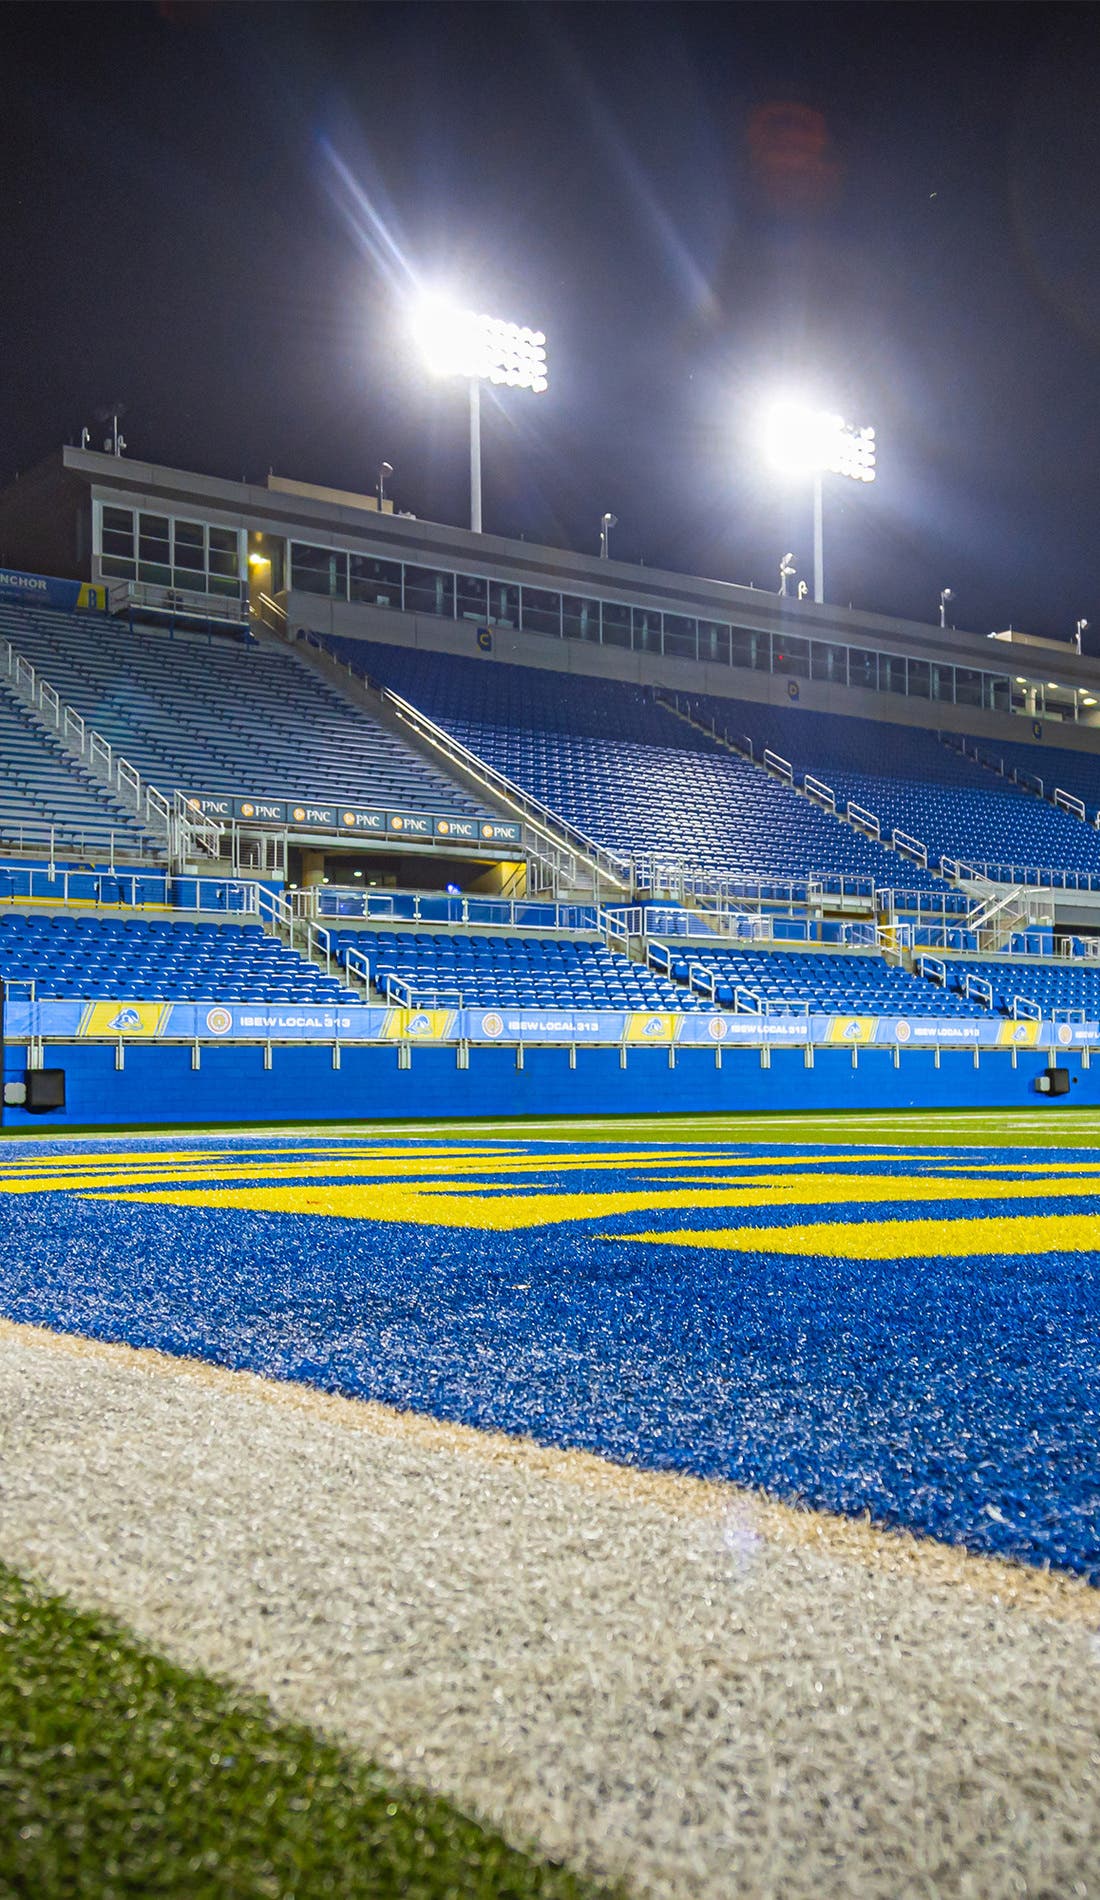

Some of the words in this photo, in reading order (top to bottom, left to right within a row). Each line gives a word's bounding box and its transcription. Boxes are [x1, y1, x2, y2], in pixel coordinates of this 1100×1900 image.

[202, 801, 228, 814] PNC
[255, 805, 281, 819] PNC
[306, 810, 331, 823] PNC
[356, 814, 380, 827] PNC
[404, 818, 427, 831] PNC
[450, 823, 472, 836] PNC
[494, 827, 515, 839] PNC
[240, 1016, 276, 1027] IBEW
[278, 1017, 322, 1028] LOCAL
[324, 1017, 351, 1028] 313
[540, 1022, 576, 1032] LOCAL
[577, 1022, 599, 1032] 313
[758, 1025, 788, 1034] LOCAL
[937, 1028, 962, 1037] LOCAL
